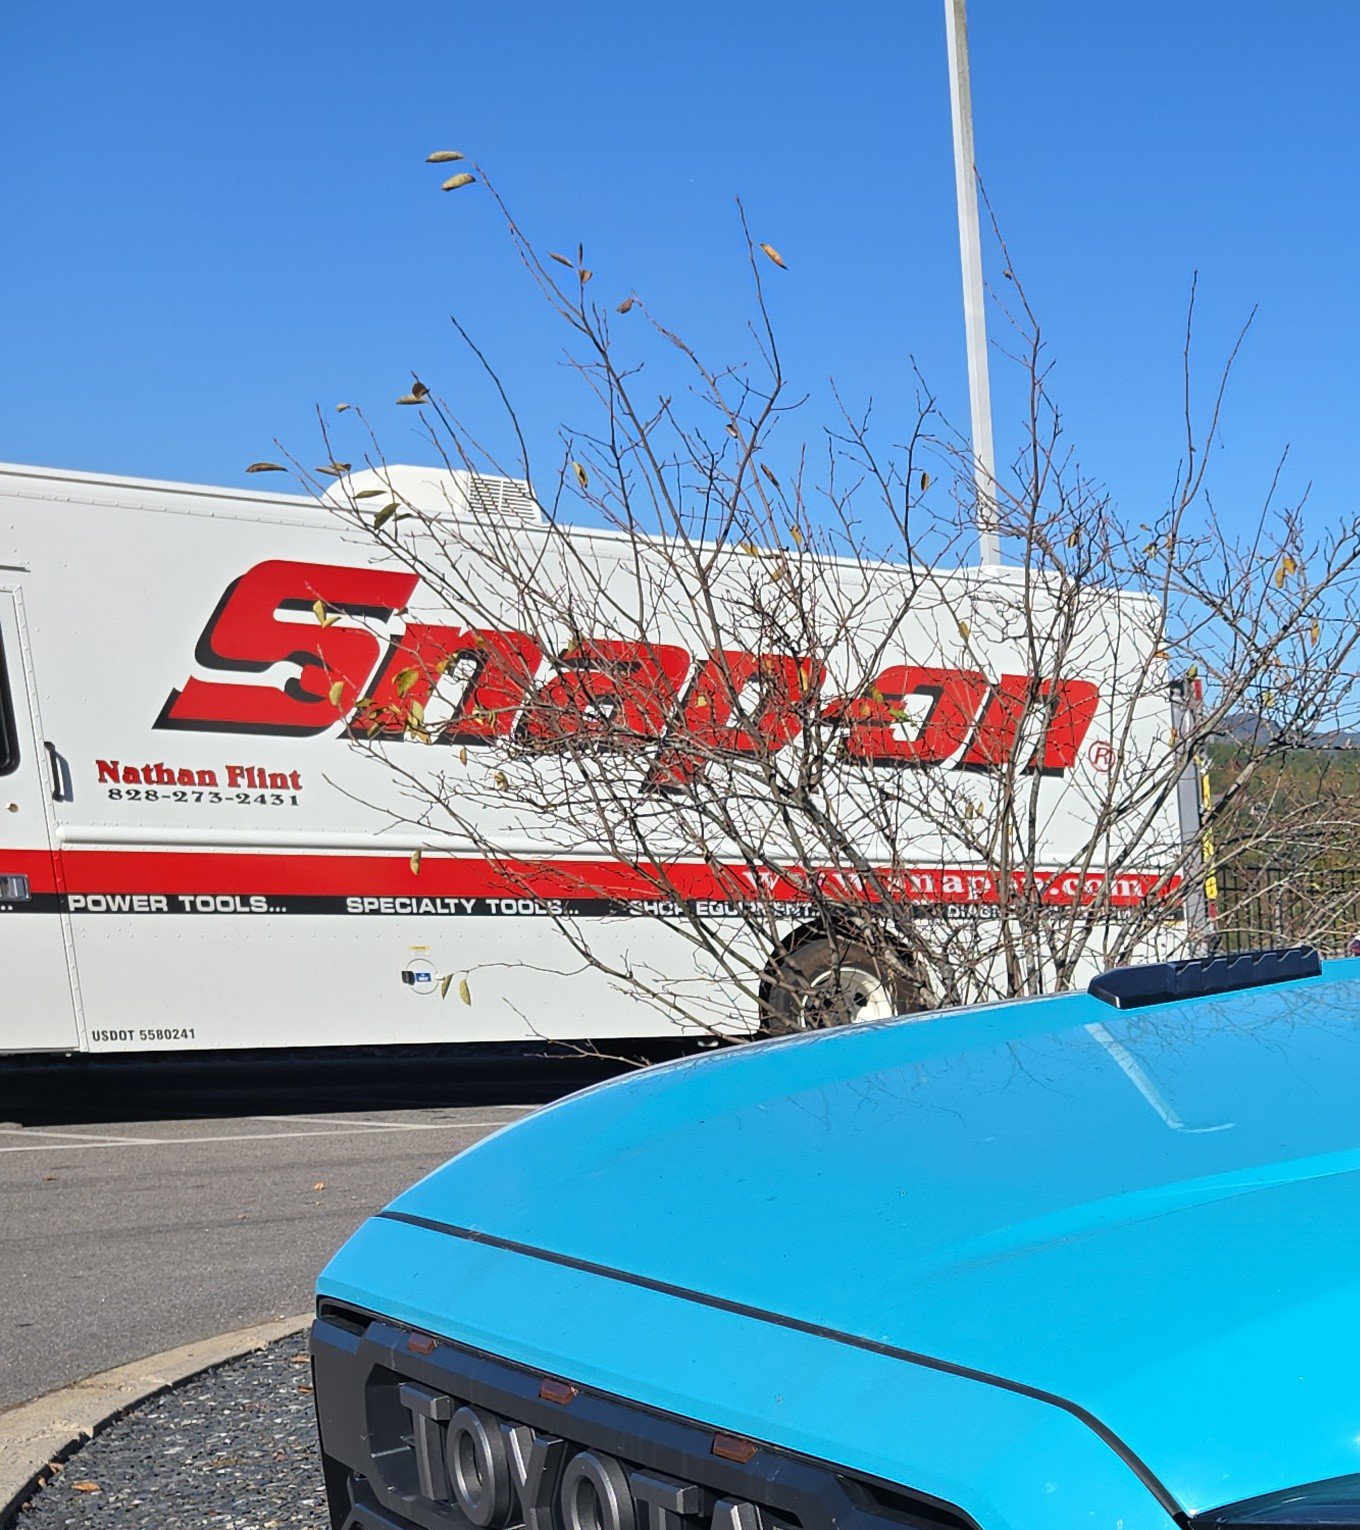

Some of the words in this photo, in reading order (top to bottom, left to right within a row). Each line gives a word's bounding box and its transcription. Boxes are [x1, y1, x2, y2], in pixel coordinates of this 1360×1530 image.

[152, 560, 1099, 793] Snap-on
[95, 759, 219, 787] Nathan
[225, 764, 304, 791] Flint
[107, 787, 300, 807] 828-273-2431
[67, 894, 169, 913] POWER
[178, 894, 287, 913] TOOLS...
[346, 896, 477, 914] SPECIALTY
[91, 1029, 135, 1042] USDOT
[140, 1027, 196, 1041] 5580241
